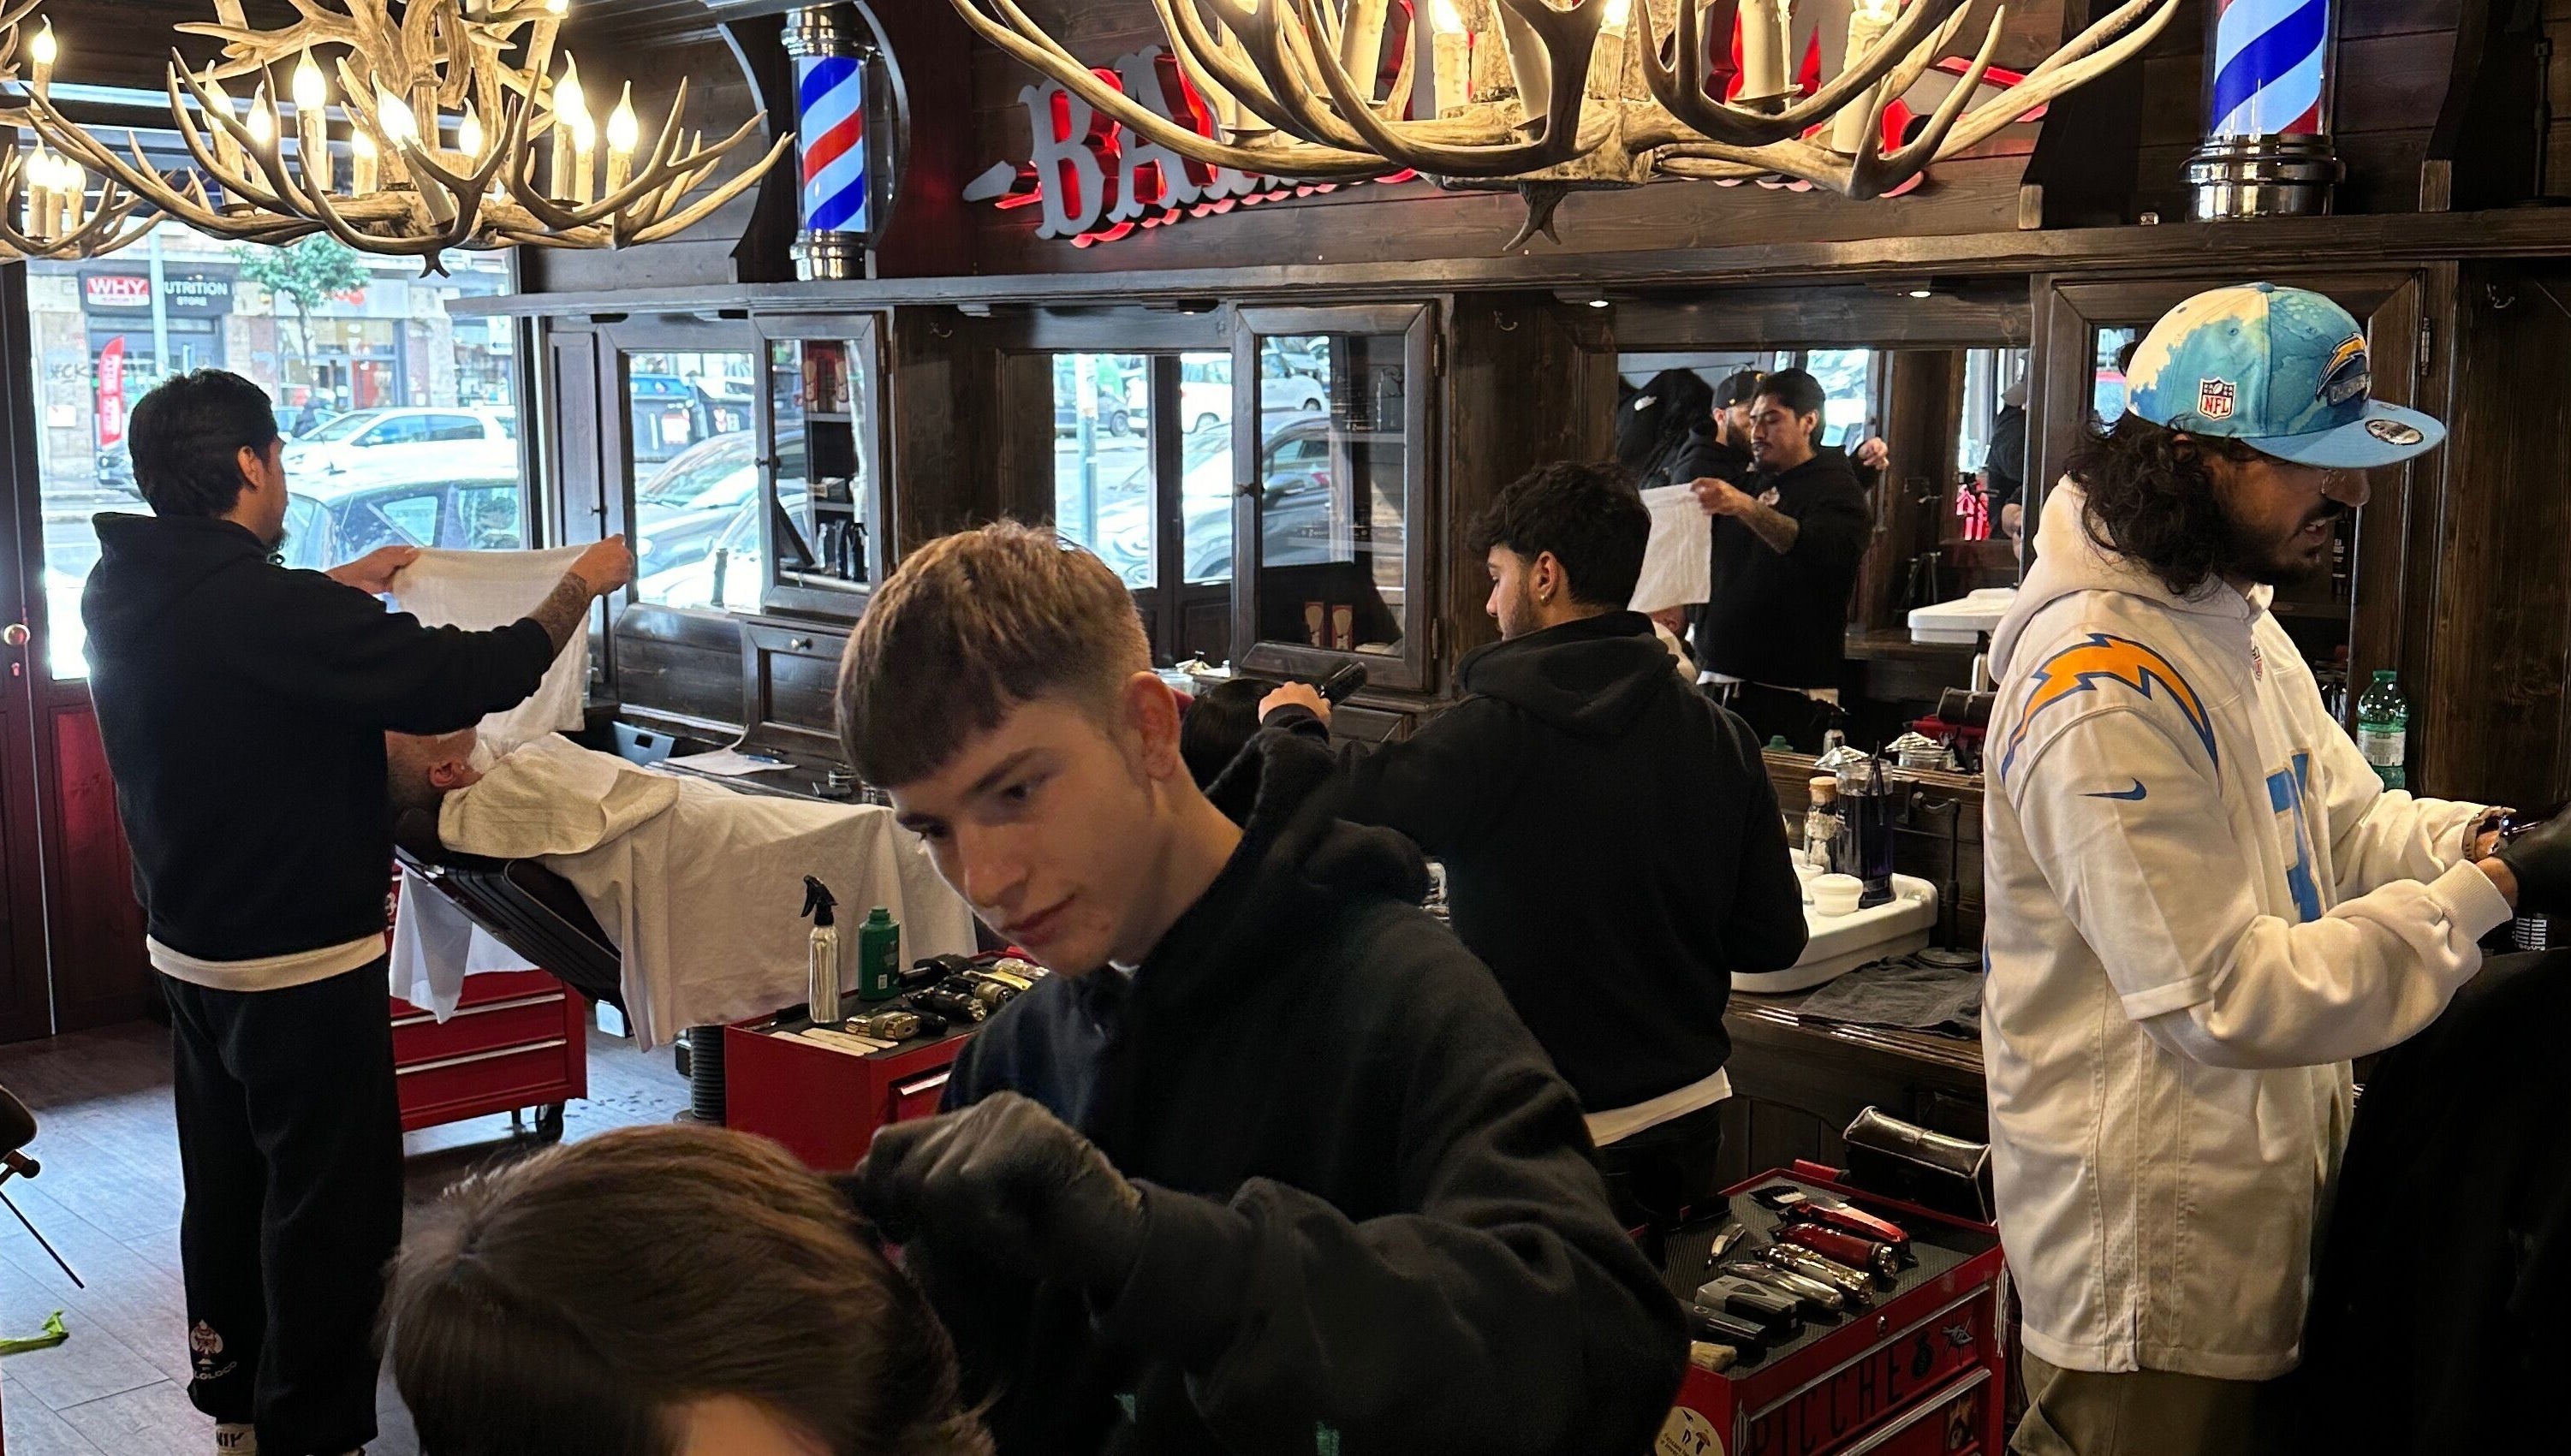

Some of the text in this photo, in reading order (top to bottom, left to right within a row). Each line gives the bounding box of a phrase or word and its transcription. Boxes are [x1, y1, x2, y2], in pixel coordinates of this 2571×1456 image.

[90, 278, 146, 295] WHY
[164, 281, 228, 295] UTRITION
[2203, 396, 2229, 414] NFL
